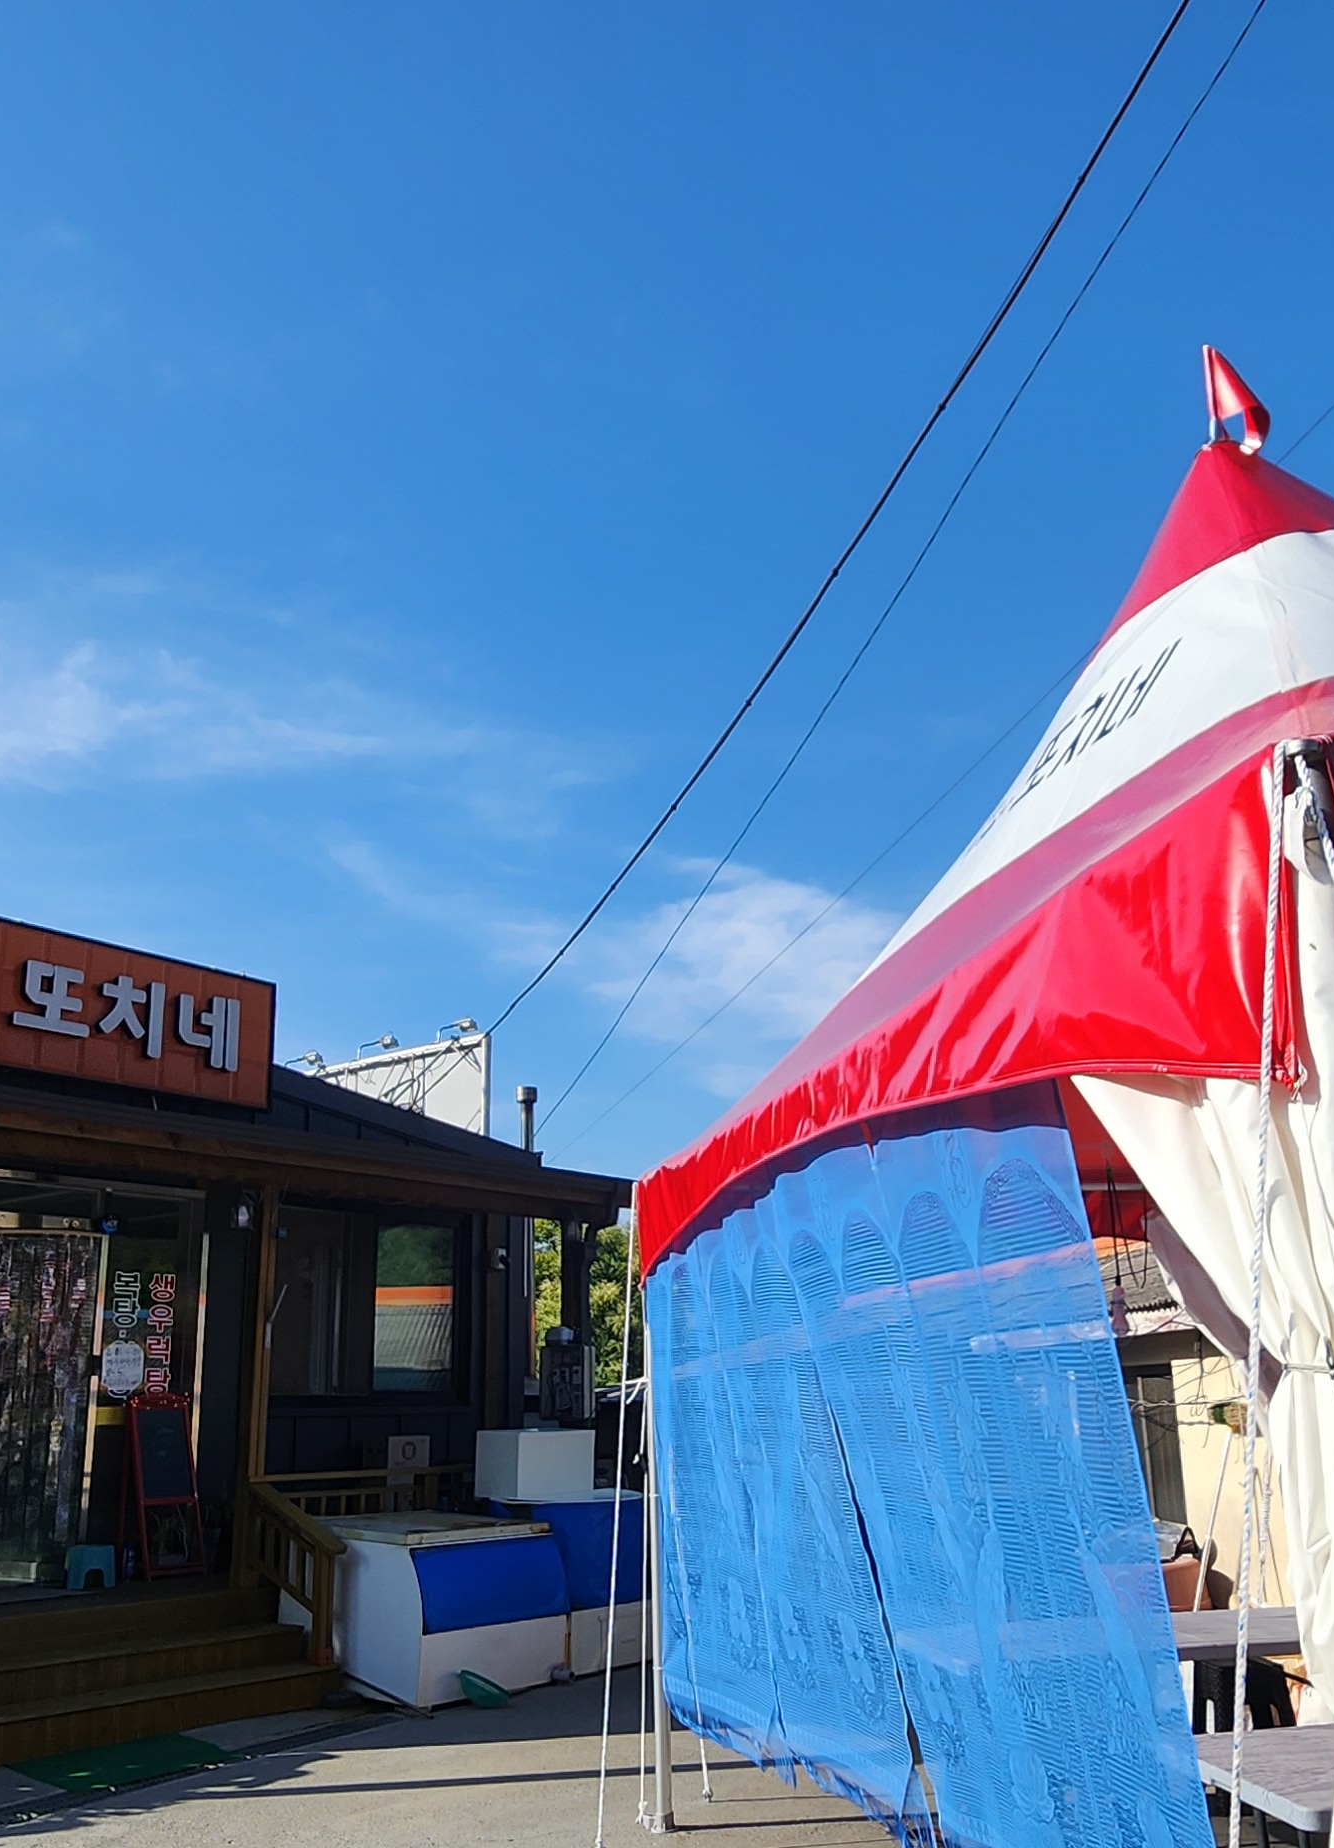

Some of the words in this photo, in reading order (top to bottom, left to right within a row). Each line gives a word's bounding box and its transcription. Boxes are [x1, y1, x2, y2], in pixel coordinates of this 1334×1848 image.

[1010, 637, 1184, 811] 또치네
[11, 959, 242, 1073] 또치네
[144, 1272, 177, 1395] 생우럭탕
